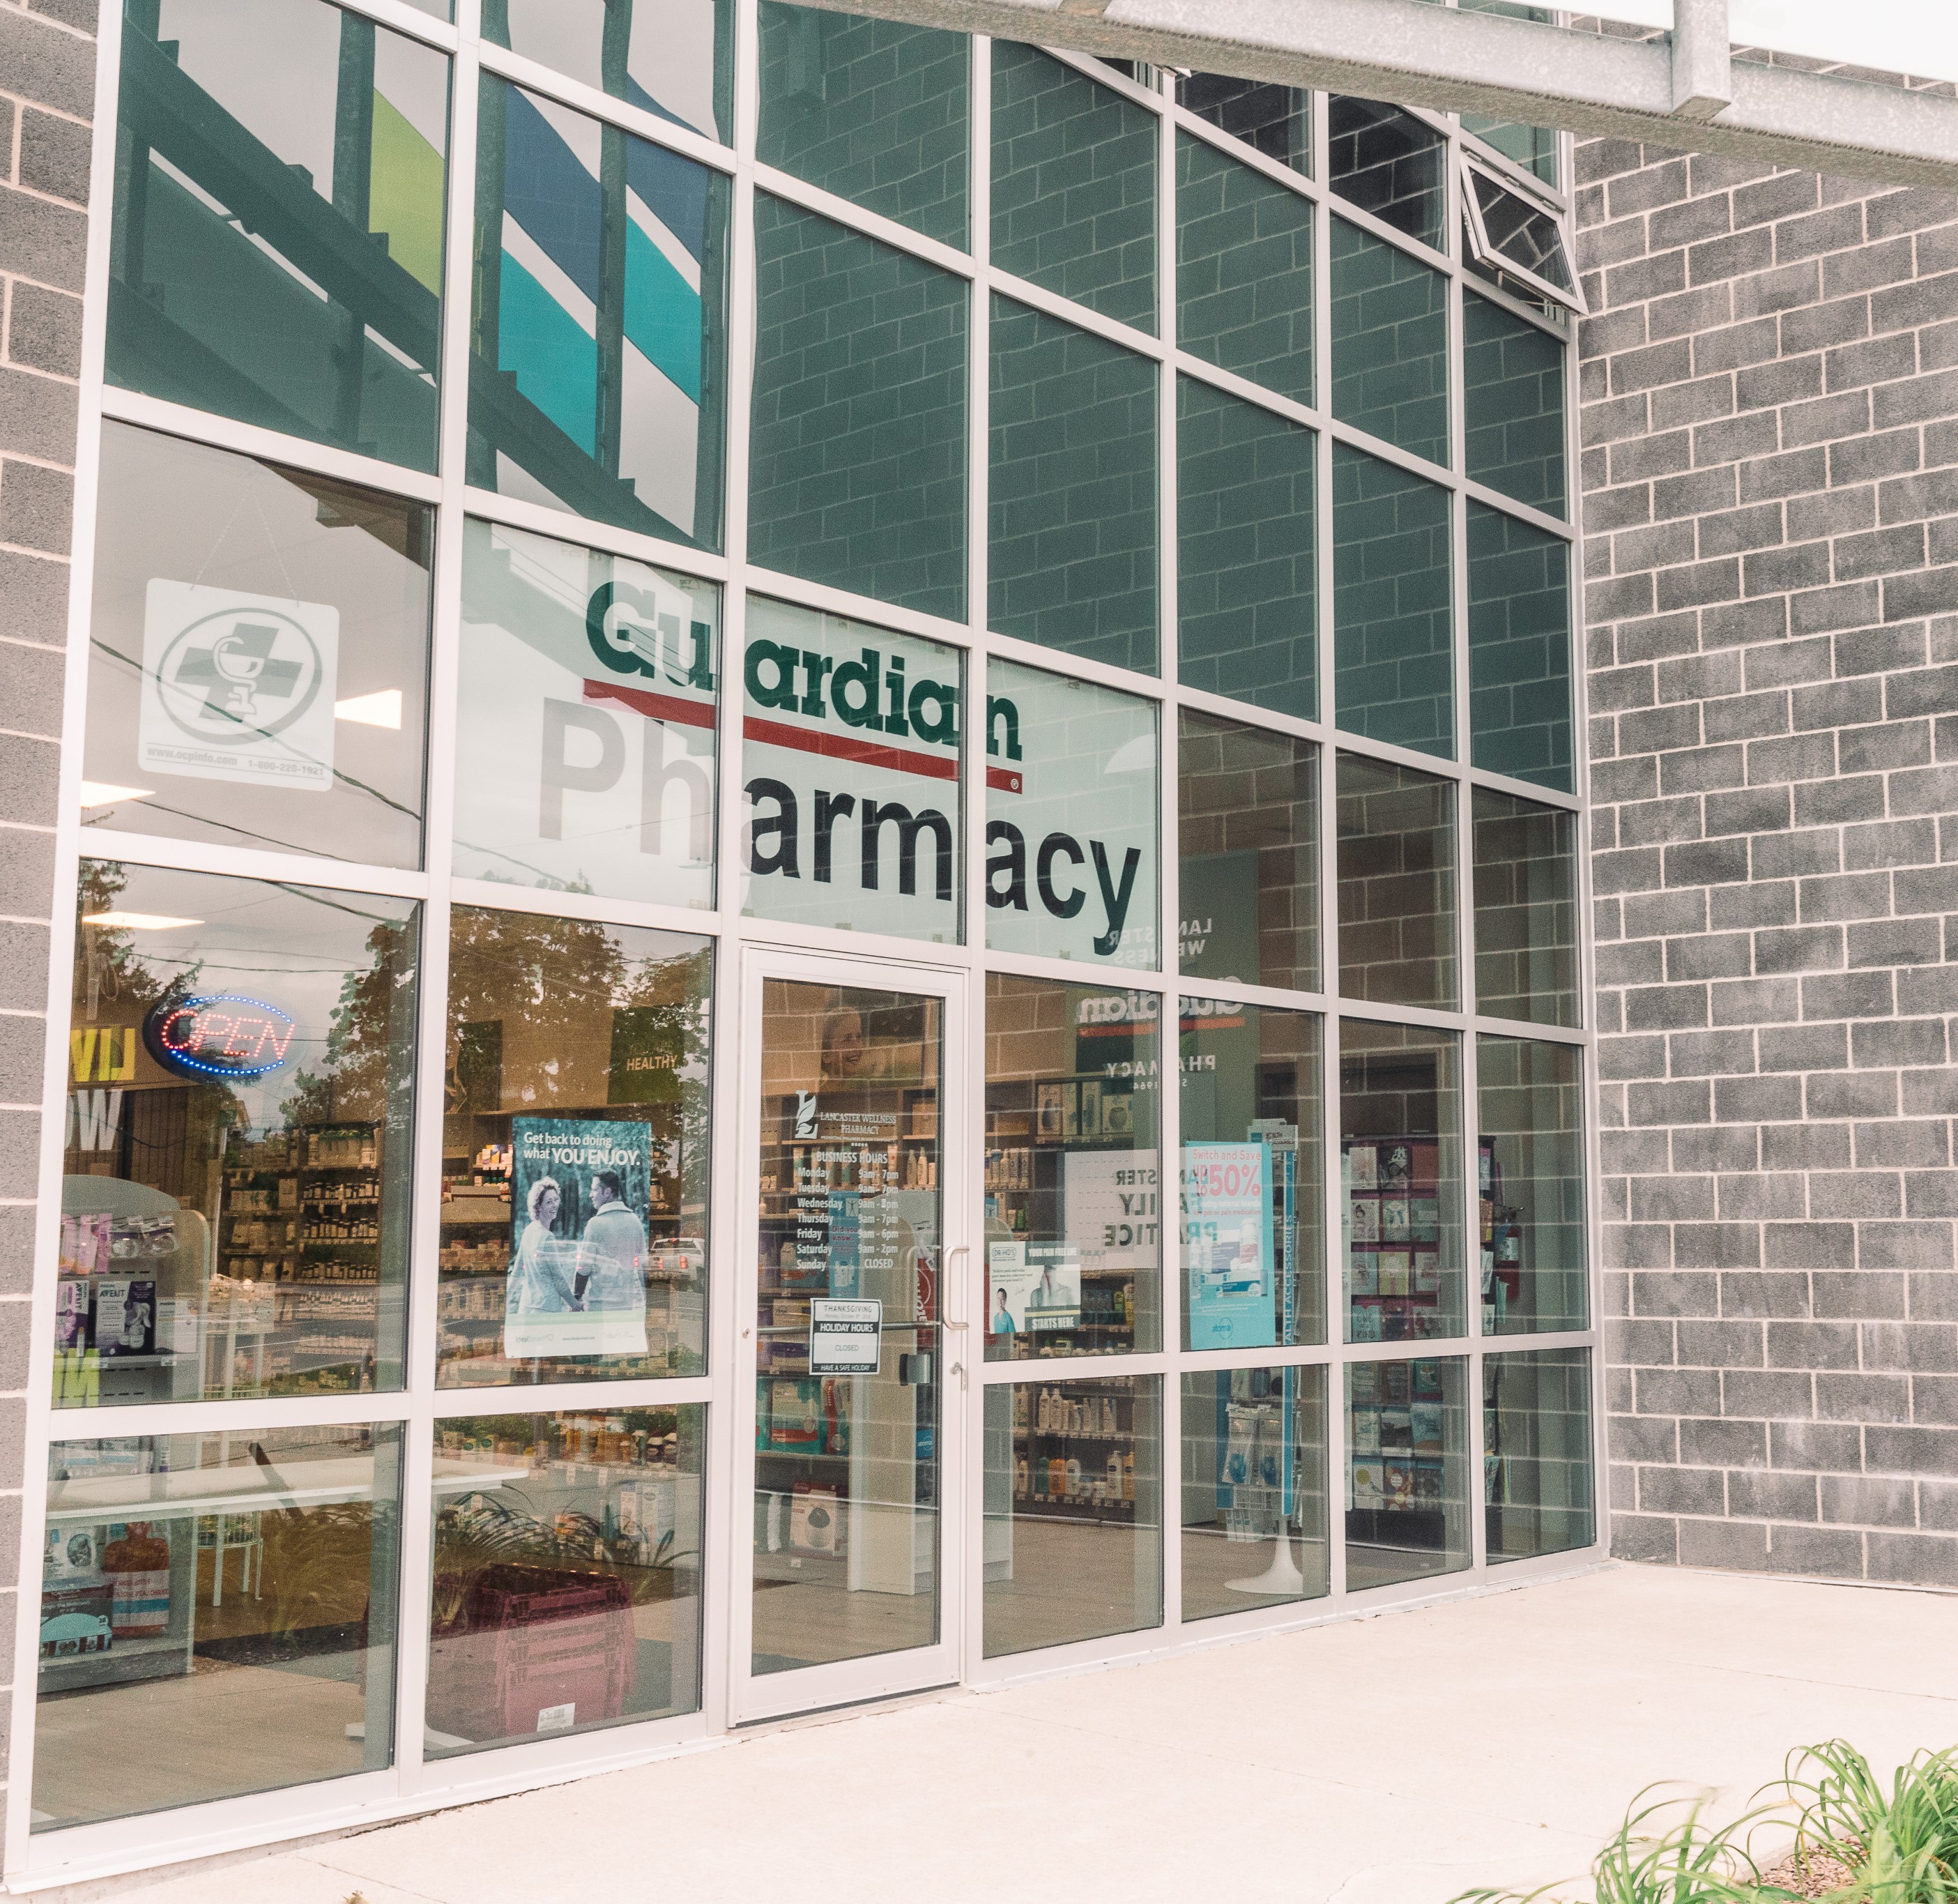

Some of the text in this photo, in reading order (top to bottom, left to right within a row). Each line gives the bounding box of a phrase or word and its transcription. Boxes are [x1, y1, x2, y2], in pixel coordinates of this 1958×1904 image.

[585, 579, 1023, 763] Guardian
[146, 747, 238, 766] www.ocpinfo.com
[539, 697, 1142, 957] Pharmacy
[161, 1008, 296, 1060] OPEN
[627, 1055, 678, 1071] HEALTHY
[820, 1112, 897, 1125] LANCASTER WELLNESS
[841, 1125, 880, 1135] PHARMACY
[523, 1132, 612, 1148] Get back to doing
[523, 1148, 641, 1166] what YOU ENJOY.
[816, 1151, 888, 1164] BUSINESS HOURS
[1193, 1149, 1262, 1161] Switch and Save
[798, 1167, 830, 1180] Monday
[858, 1169, 875, 1178] 9am
[882, 1170, 898, 1181] 7pm
[1209, 1164, 1261, 1198] 50%
[797, 1182, 830, 1195] Tuesday
[858, 1185, 875, 1194] 9am
[882, 1185, 898, 1196] 7pm
[797, 1197, 843, 1210] Wednesday
[857, 1200, 875, 1208] 9am
[797, 1212, 834, 1226] Thursday
[858, 1215, 875, 1224] 9am
[882, 1215, 898, 1226] 7pm
[797, 1228, 823, 1241] Friday
[857, 1230, 875, 1239] 9am
[881, 1231, 898, 1241] 6pm
[797, 1244, 833, 1256] Saturday
[857, 1245, 875, 1254] 9am
[881, 1245, 898, 1256] 2pm
[797, 1258, 894, 1272] Sunday CLOSED
[824, 1304, 873, 1313] THANKSGIVING
[820, 1323, 873, 1332] HOLIDAY HOURS
[1032, 1316, 1075, 1330] STARTS HERE
